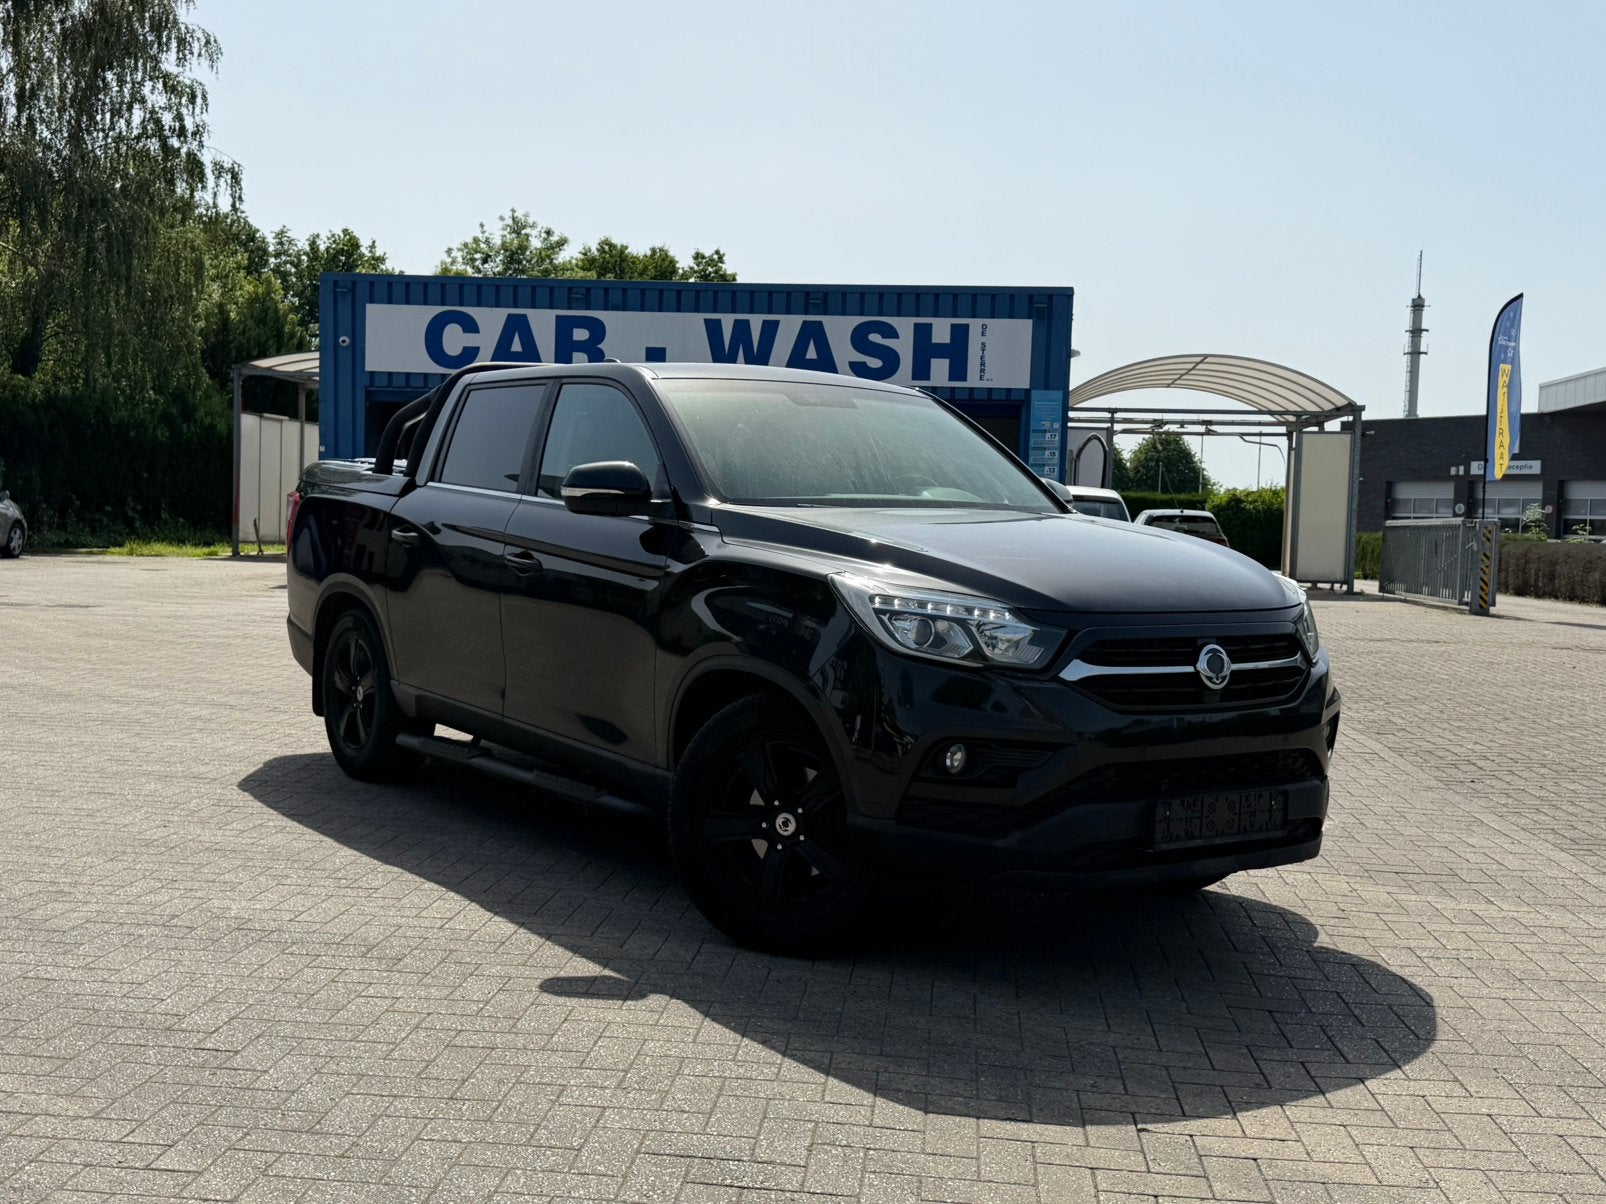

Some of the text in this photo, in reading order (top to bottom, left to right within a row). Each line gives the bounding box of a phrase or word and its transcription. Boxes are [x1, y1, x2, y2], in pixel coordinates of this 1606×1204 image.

[425, 309, 607, 369] CAR
[704, 318, 970, 382] WASH
[979, 324, 988, 382] DE STERRE
[1508, 463, 1533, 471] eceptie
